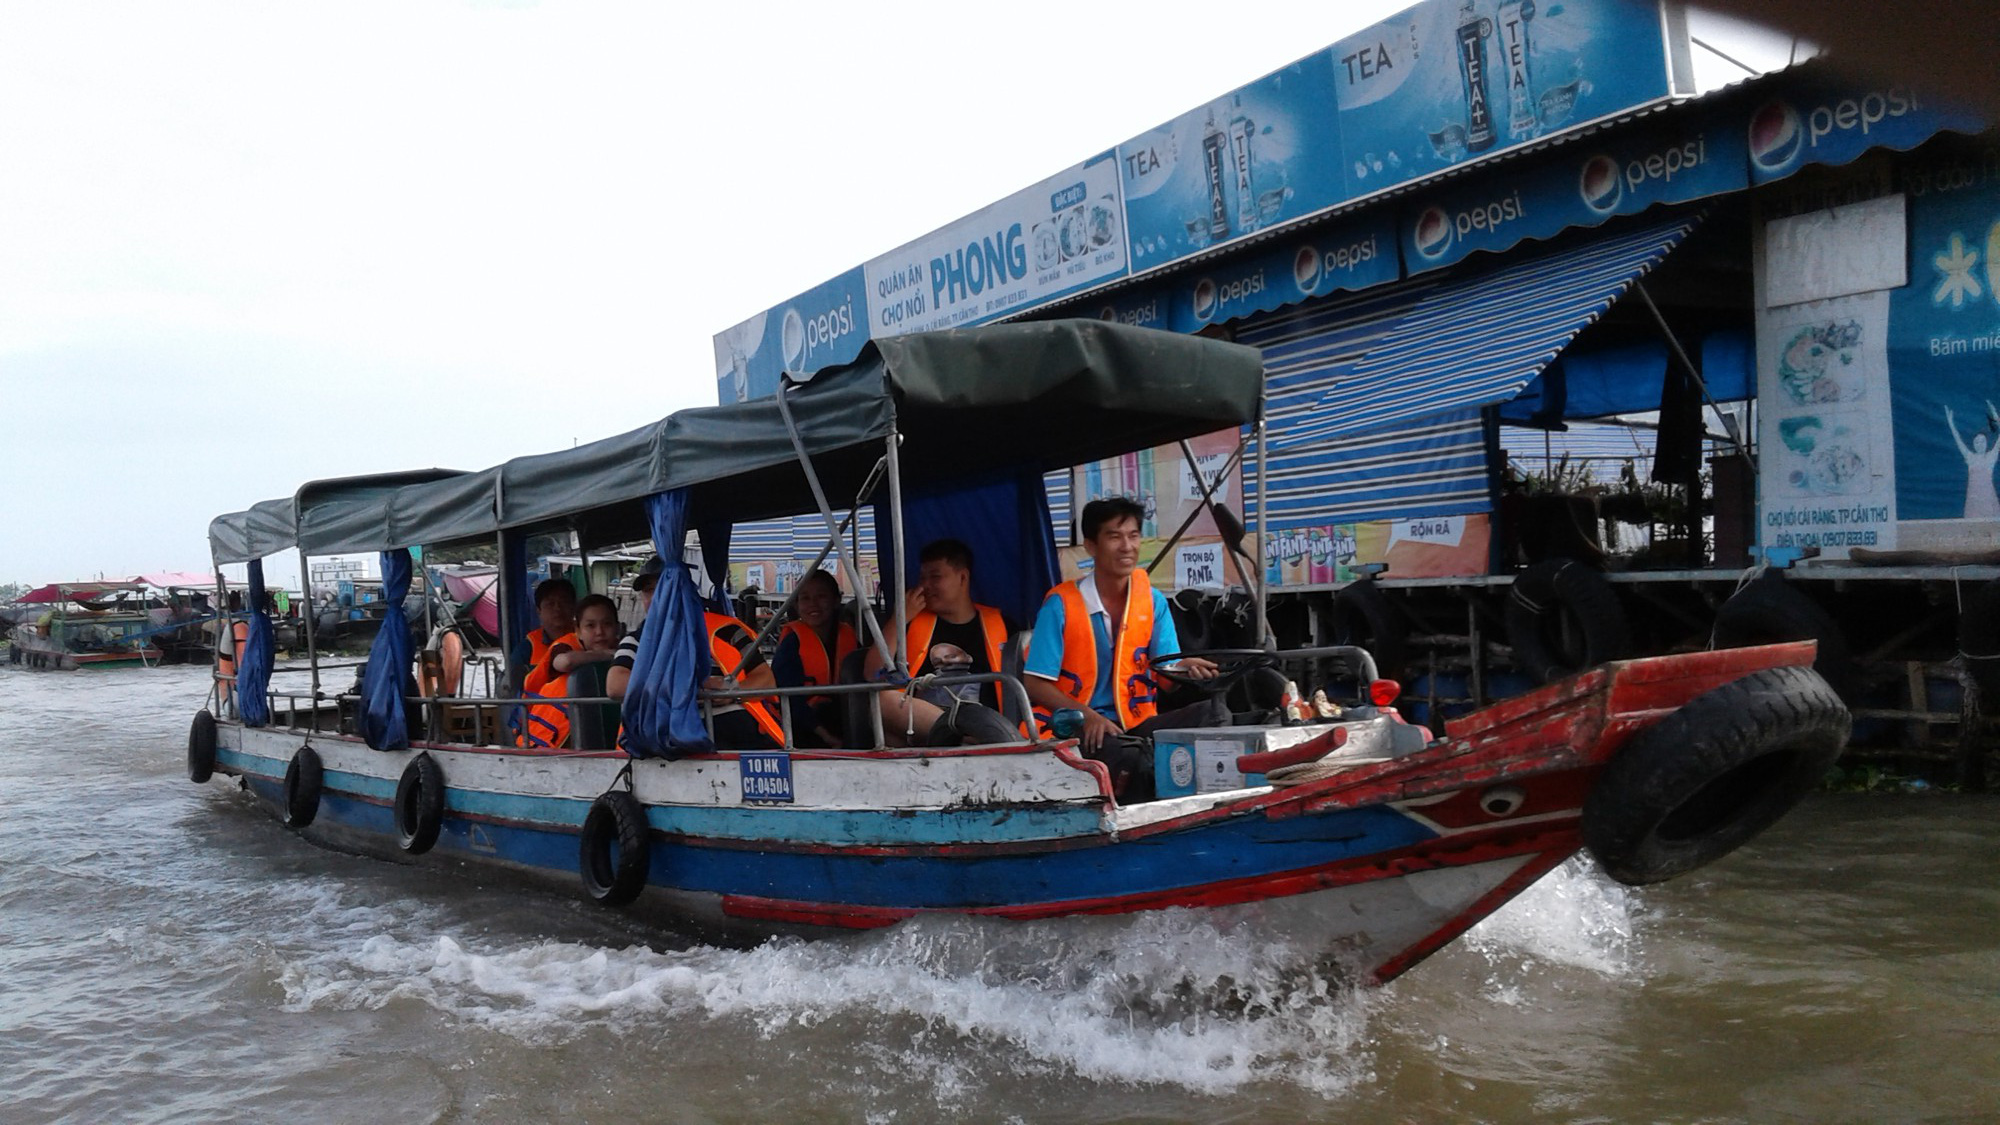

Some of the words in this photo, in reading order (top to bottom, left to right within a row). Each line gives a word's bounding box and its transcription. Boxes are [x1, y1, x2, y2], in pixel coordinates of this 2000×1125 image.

[1409, 24, 1420, 60] PLUS
[1341, 42, 1393, 86] TEA
[1809, 88, 1918, 147] pepsi
[1125, 146, 1160, 180] TEA
[1625, 134, 1706, 193] pepsi
[1456, 190, 1523, 242] pepsi
[930, 222, 1027, 311] PHONG
[1324, 233, 1377, 279] pepsi
[878, 270, 906, 298] QUÁN
[1219, 268, 1265, 309] pepsi
[807, 293, 854, 359] pepsi
[881, 302, 904, 328] CHỢ
[906, 288, 926, 319] NỔI
[1280, 532, 1309, 560] FANTA
[1411, 520, 1433, 541] RỘN
[1182, 552, 1203, 565] TRỌN
[1203, 549, 1215, 563] BỘ
[1187, 565, 1214, 587] FANTA
[743, 776, 790, 795] CT:04504
[747, 758, 762, 773] 10
[763, 758, 780, 775] HK
